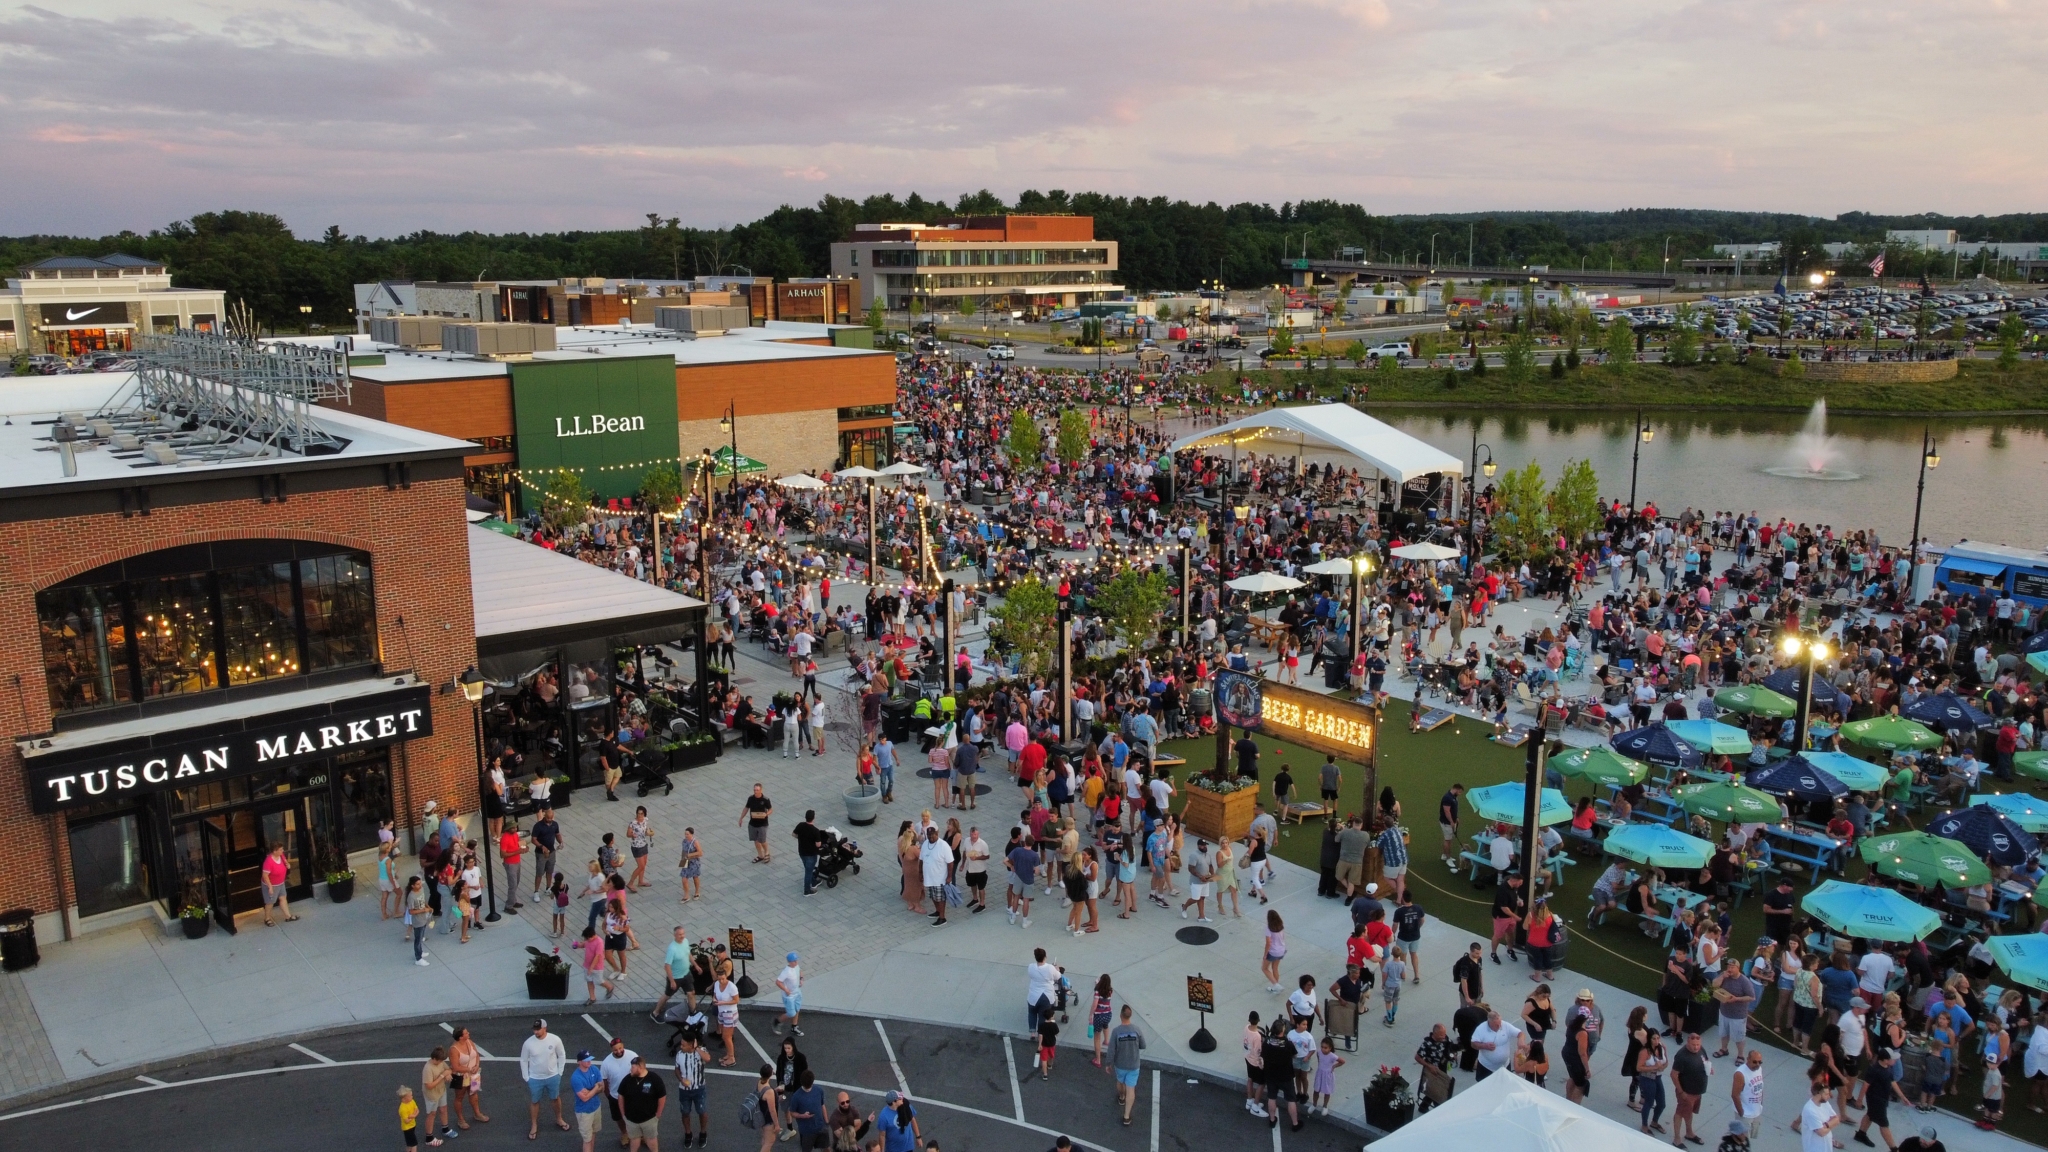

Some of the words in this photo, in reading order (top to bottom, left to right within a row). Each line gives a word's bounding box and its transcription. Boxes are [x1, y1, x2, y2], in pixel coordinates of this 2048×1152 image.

[788, 288, 824, 298] ARHAUS
[555, 414, 645, 437] L.L.Bean
[1242, 676, 1261, 700] ADMS
[1261, 695, 1301, 729] BEER
[1304, 709, 1372, 749] GARDEN
[48, 746, 229, 802] TUSCAN
[256, 709, 422, 762] MARKET
[309, 774, 327, 786] 600
[1497, 812, 1514, 820] TRULY
[1816, 907, 1831, 919] TRULY
[1863, 913, 1894, 922] TRULY
[1349, 944, 1356, 958] 2
